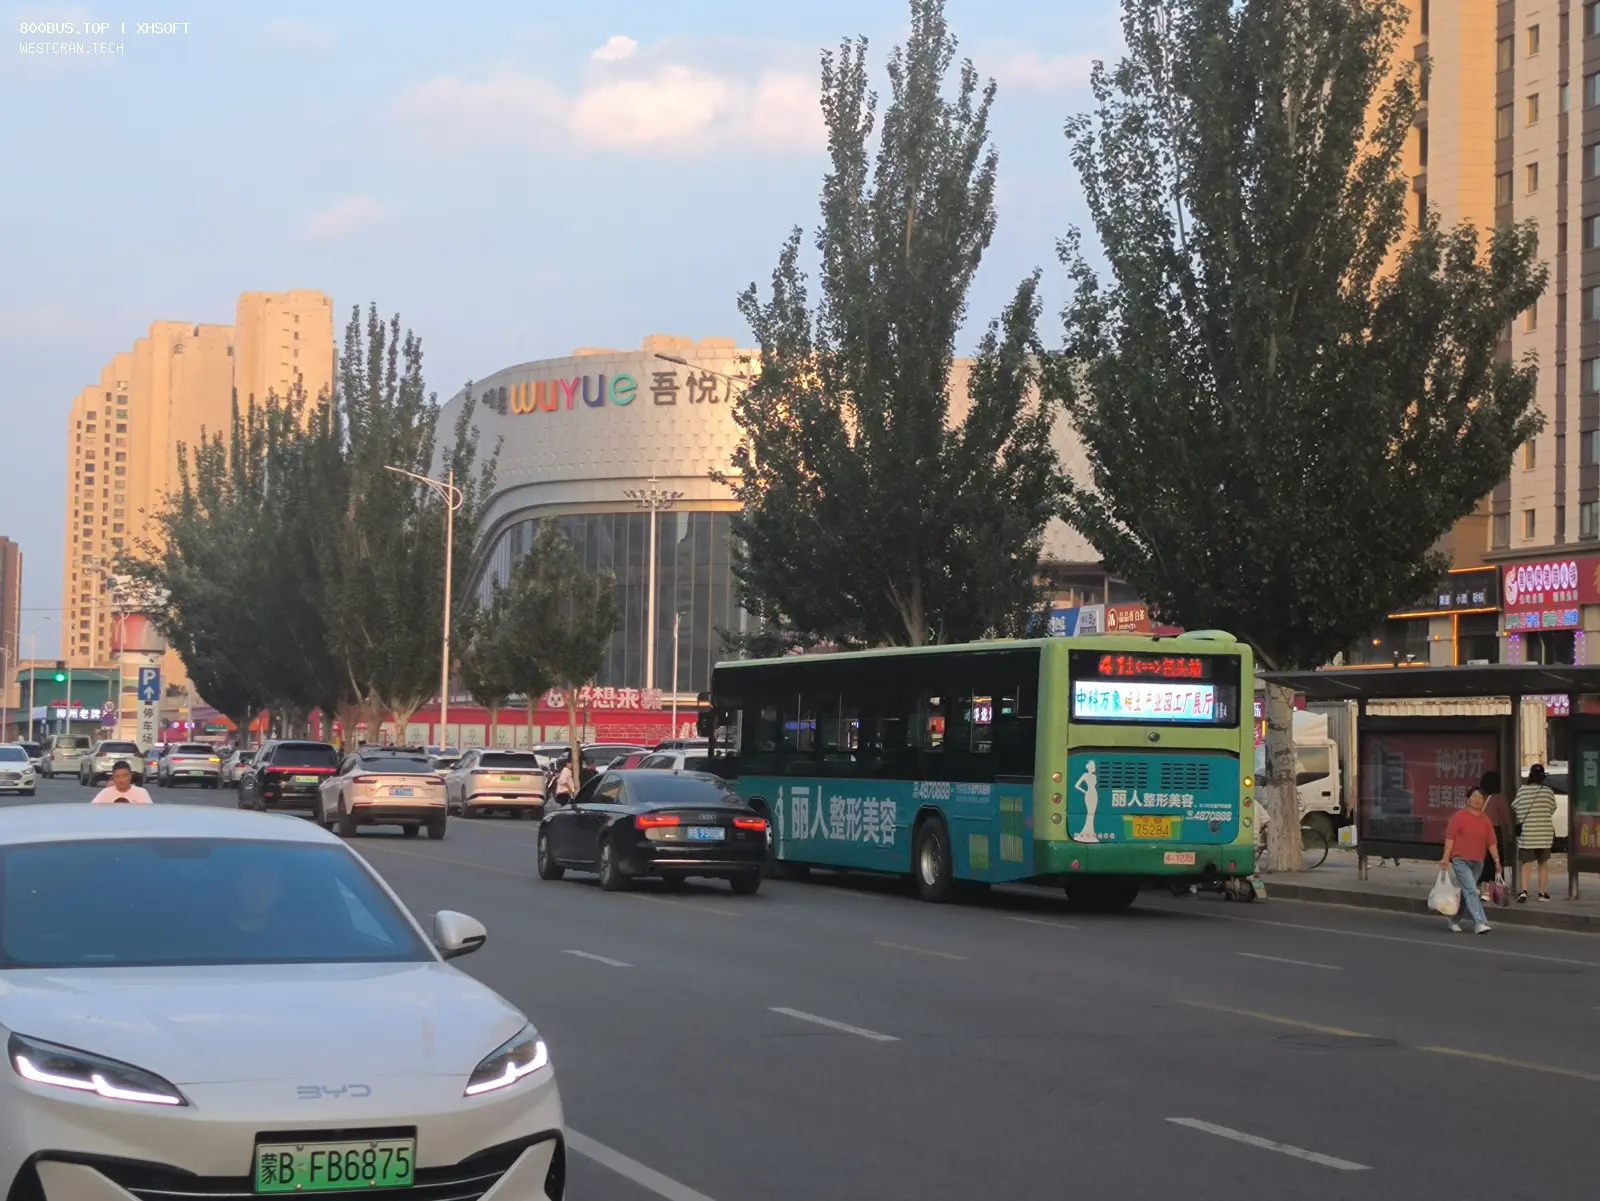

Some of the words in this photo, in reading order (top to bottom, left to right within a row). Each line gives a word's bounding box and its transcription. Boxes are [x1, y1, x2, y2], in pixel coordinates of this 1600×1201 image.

[143, 669, 156, 685] P
[56, 708, 117, 720] 柳州老牌
[143, 708, 154, 743] 停车场
[1435, 748, 1484, 779] 种好牙
[1111, 789, 1194, 808] 丽人整形美容
[1428, 784, 1473, 808] 到幸福
[791, 785, 897, 845] 丽人整形美容
[1194, 810, 1232, 821] 4870888
[1136, 824, 1170, 836] 75284
[296, 1084, 371, 1100] BYD
[261, 1152, 294, 1184] 蒙B
[310, 1147, 410, 1183] FB6875
